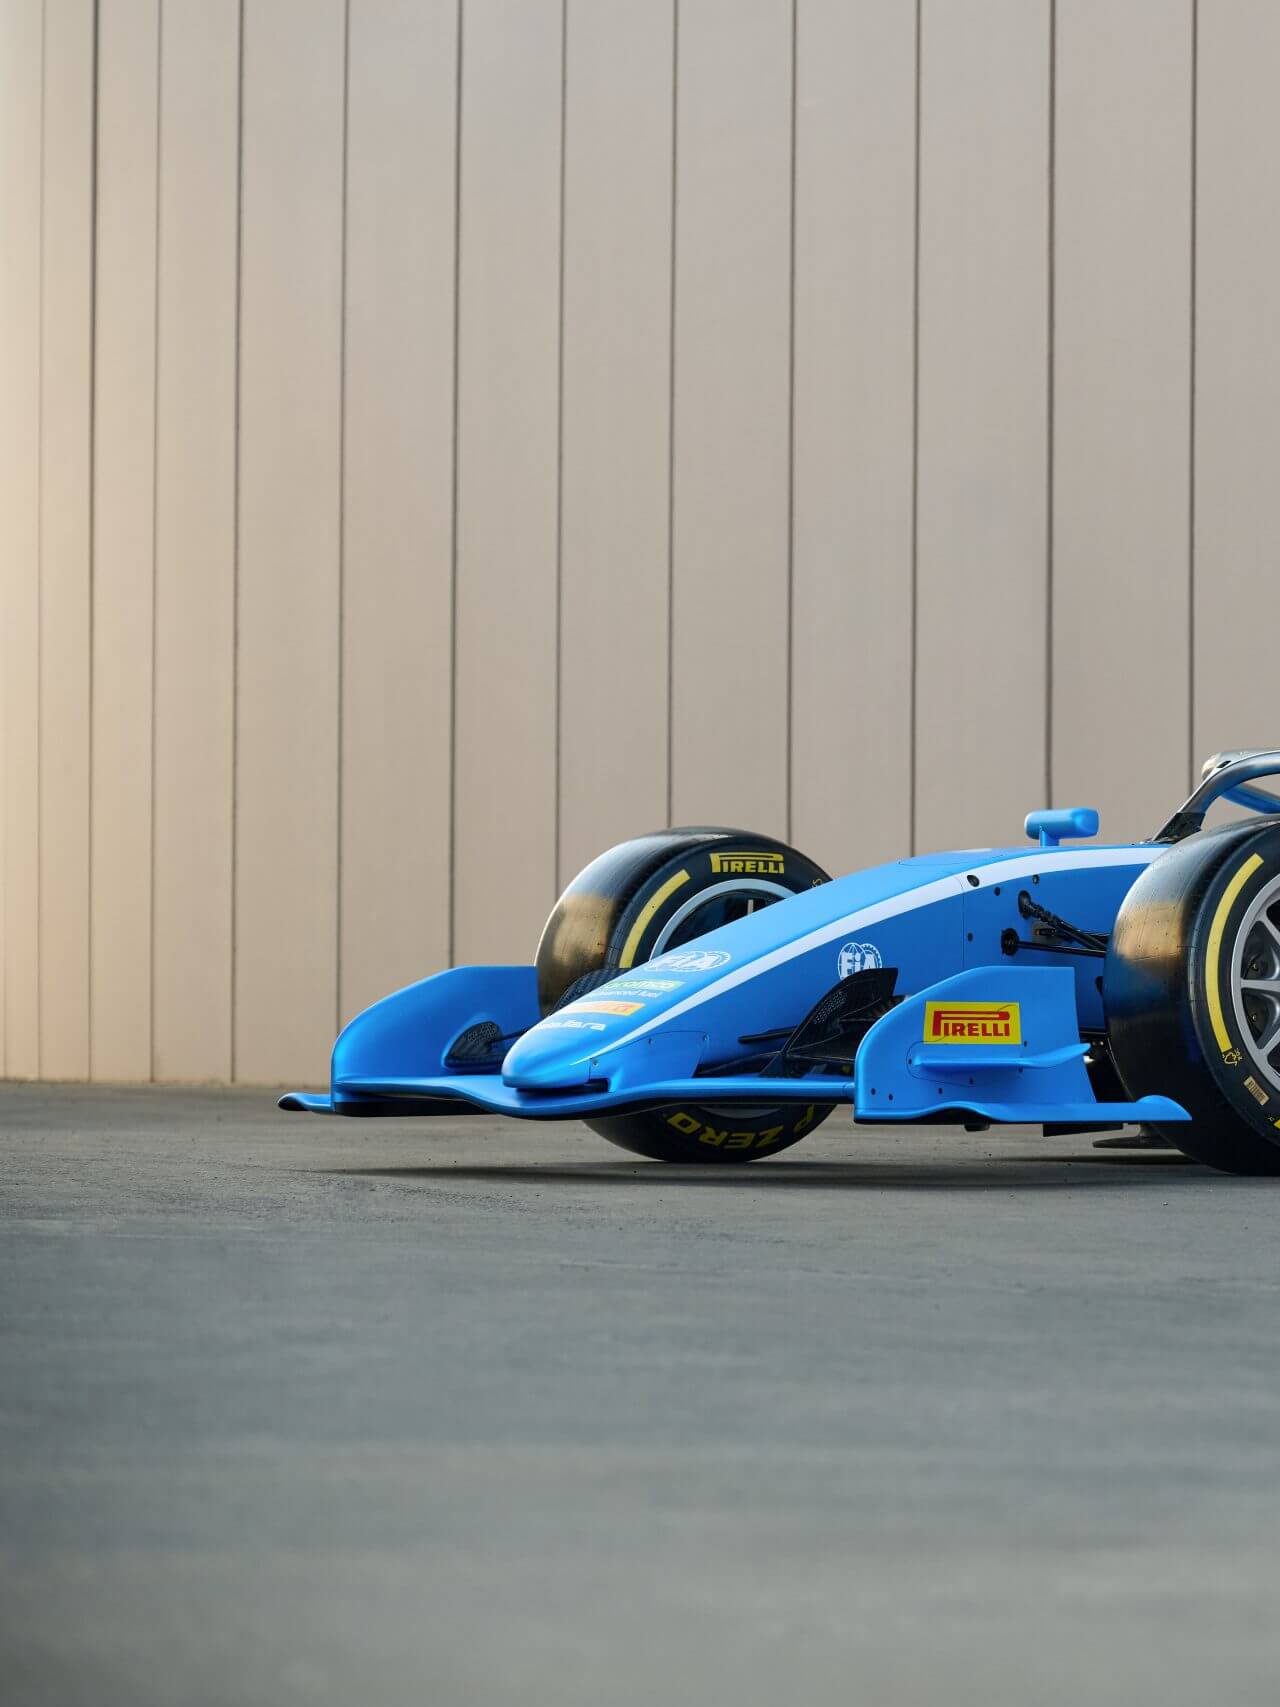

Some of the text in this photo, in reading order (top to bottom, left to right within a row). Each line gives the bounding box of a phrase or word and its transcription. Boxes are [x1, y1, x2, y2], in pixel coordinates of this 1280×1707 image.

[710, 852, 785, 873] PIRELLI
[932, 1010, 1010, 1037] PIRELLI
[667, 1112, 784, 1149] ZERO
